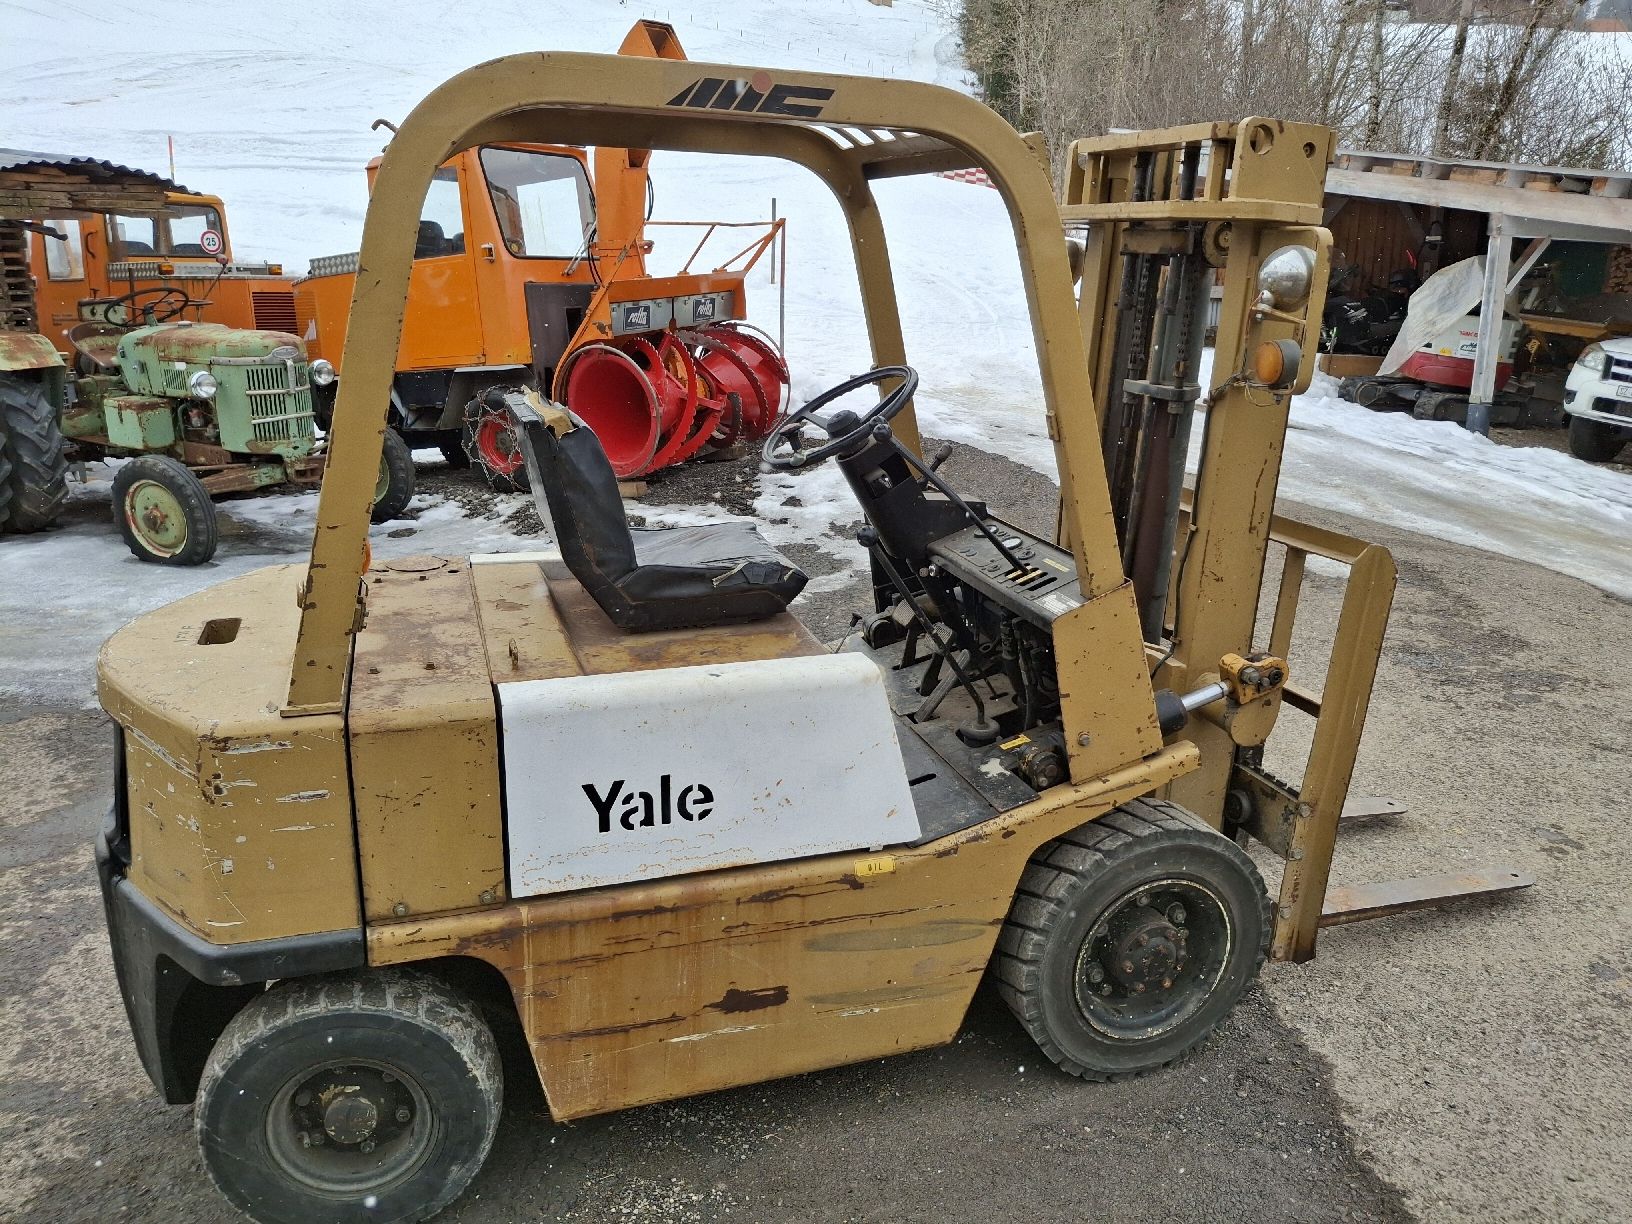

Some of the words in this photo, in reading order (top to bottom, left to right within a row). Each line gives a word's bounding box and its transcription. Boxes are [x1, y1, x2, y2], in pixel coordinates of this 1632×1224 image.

[205, 237, 217, 247] 25
[581, 774, 715, 833] Yale
[867, 862, 883, 872] OIL
